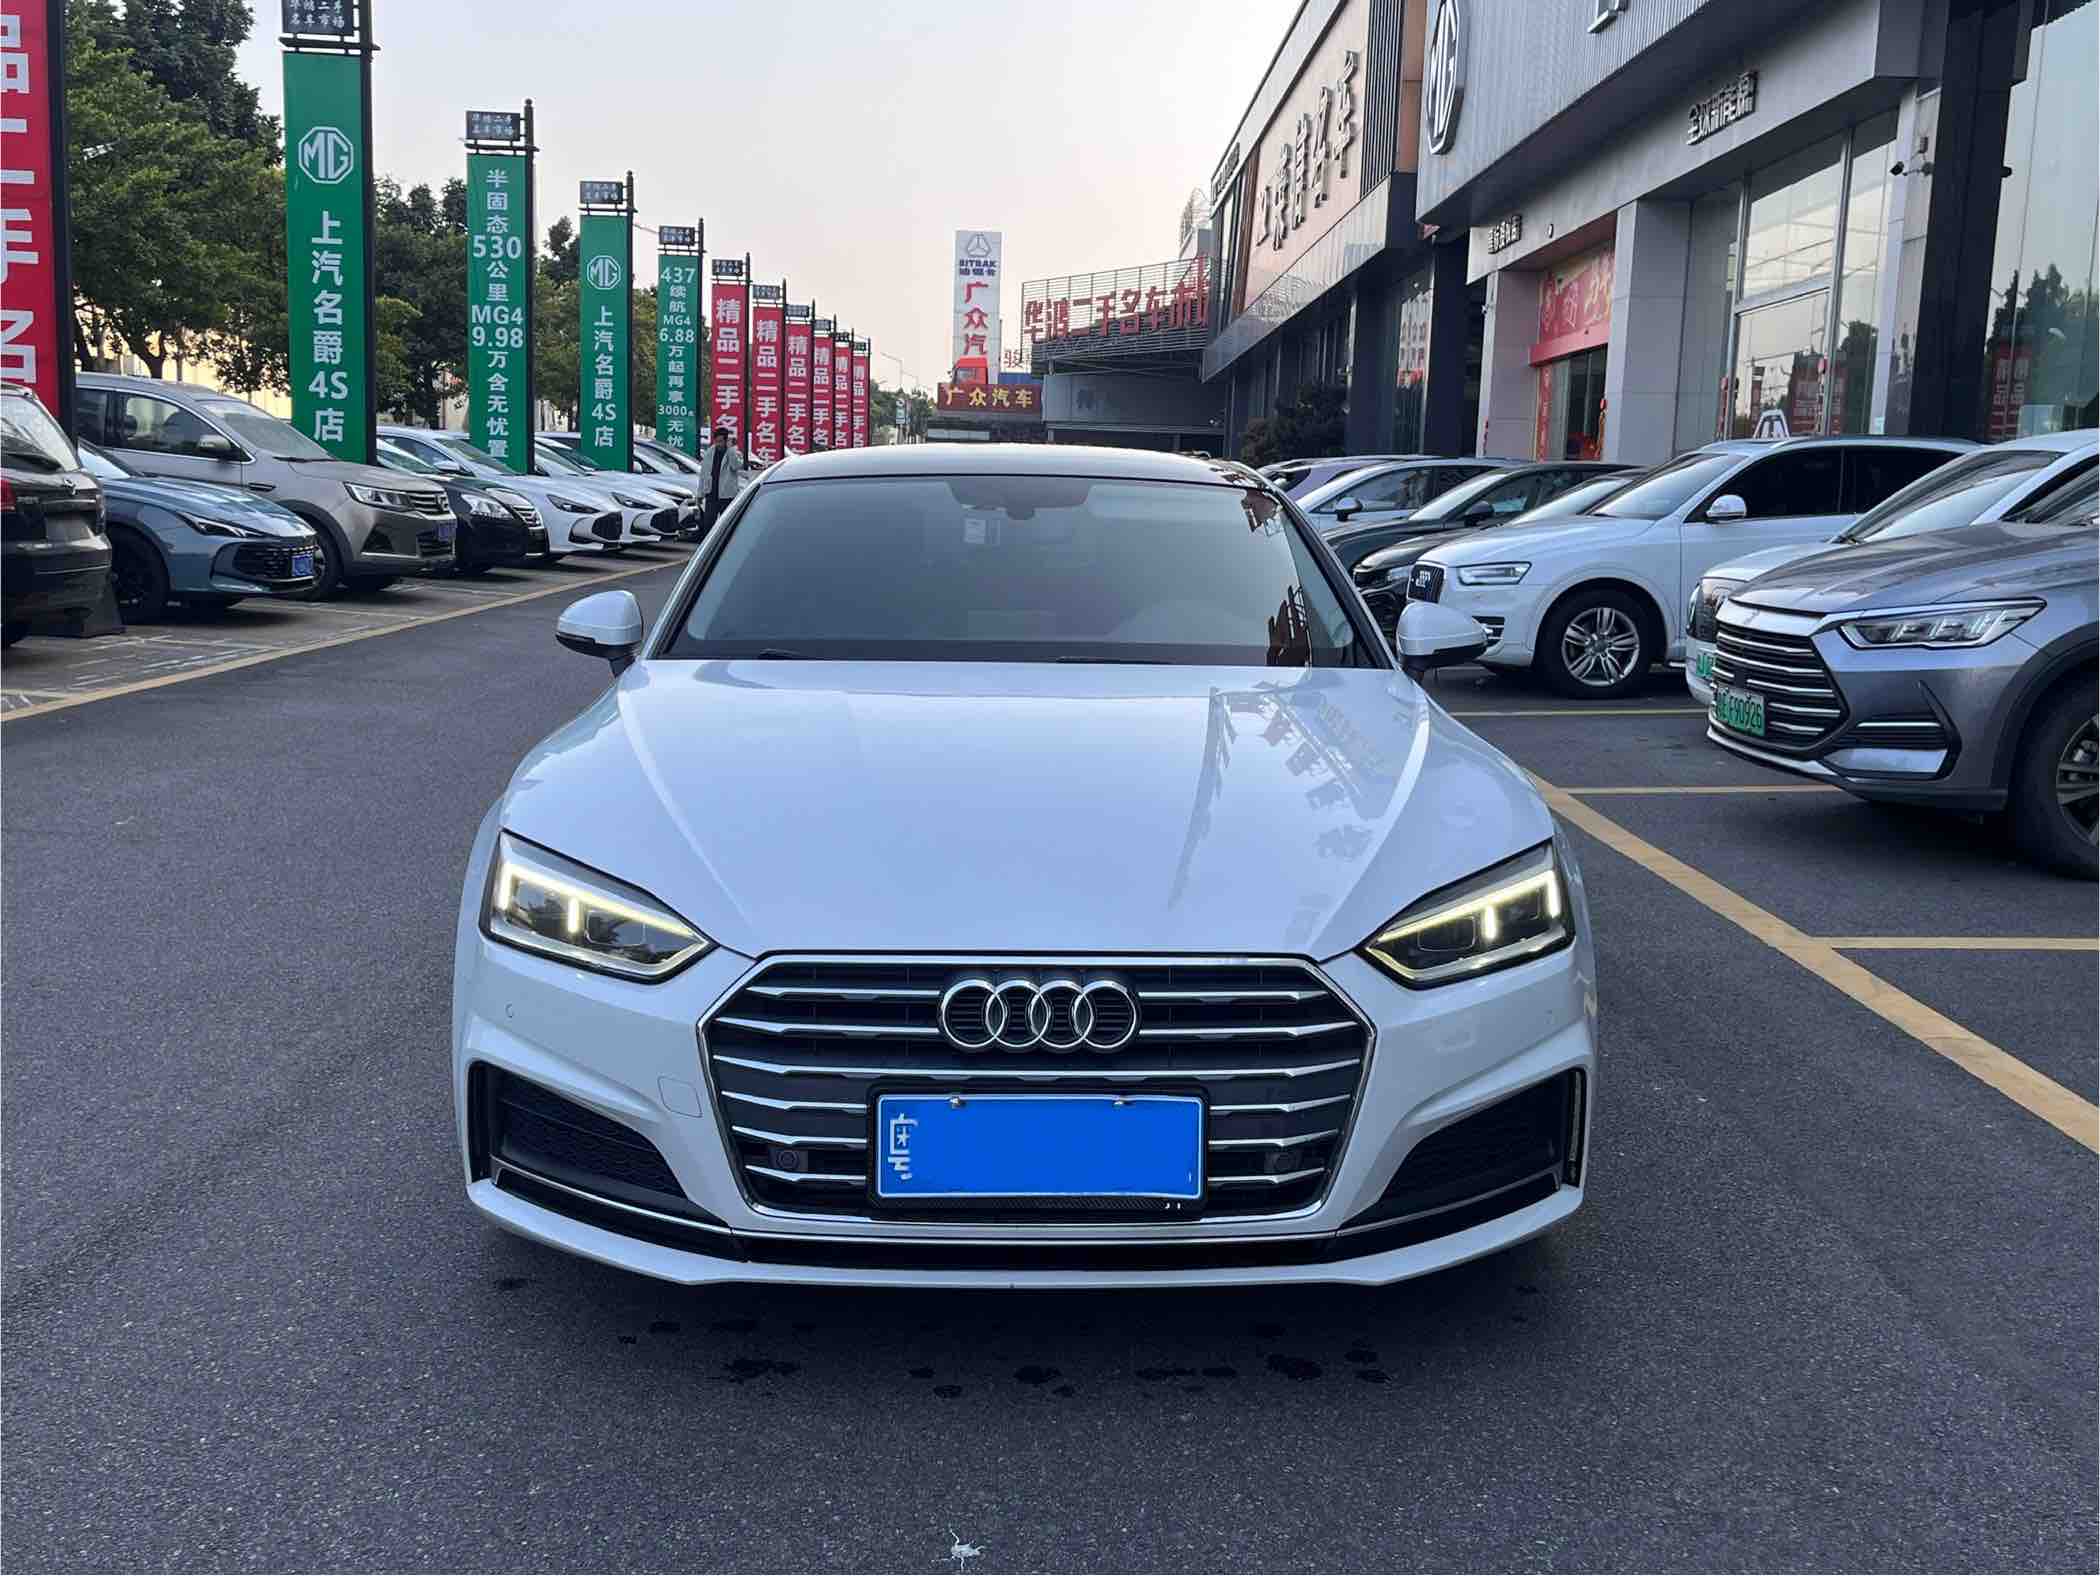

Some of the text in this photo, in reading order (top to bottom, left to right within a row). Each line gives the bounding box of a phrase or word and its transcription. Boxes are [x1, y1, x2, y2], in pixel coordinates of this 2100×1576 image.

[301, 129, 351, 181] MG
[588, 257, 619, 288] MG
[787, 336, 807, 453] 精品二手名
[945, 387, 1033, 408] 广众汽车
